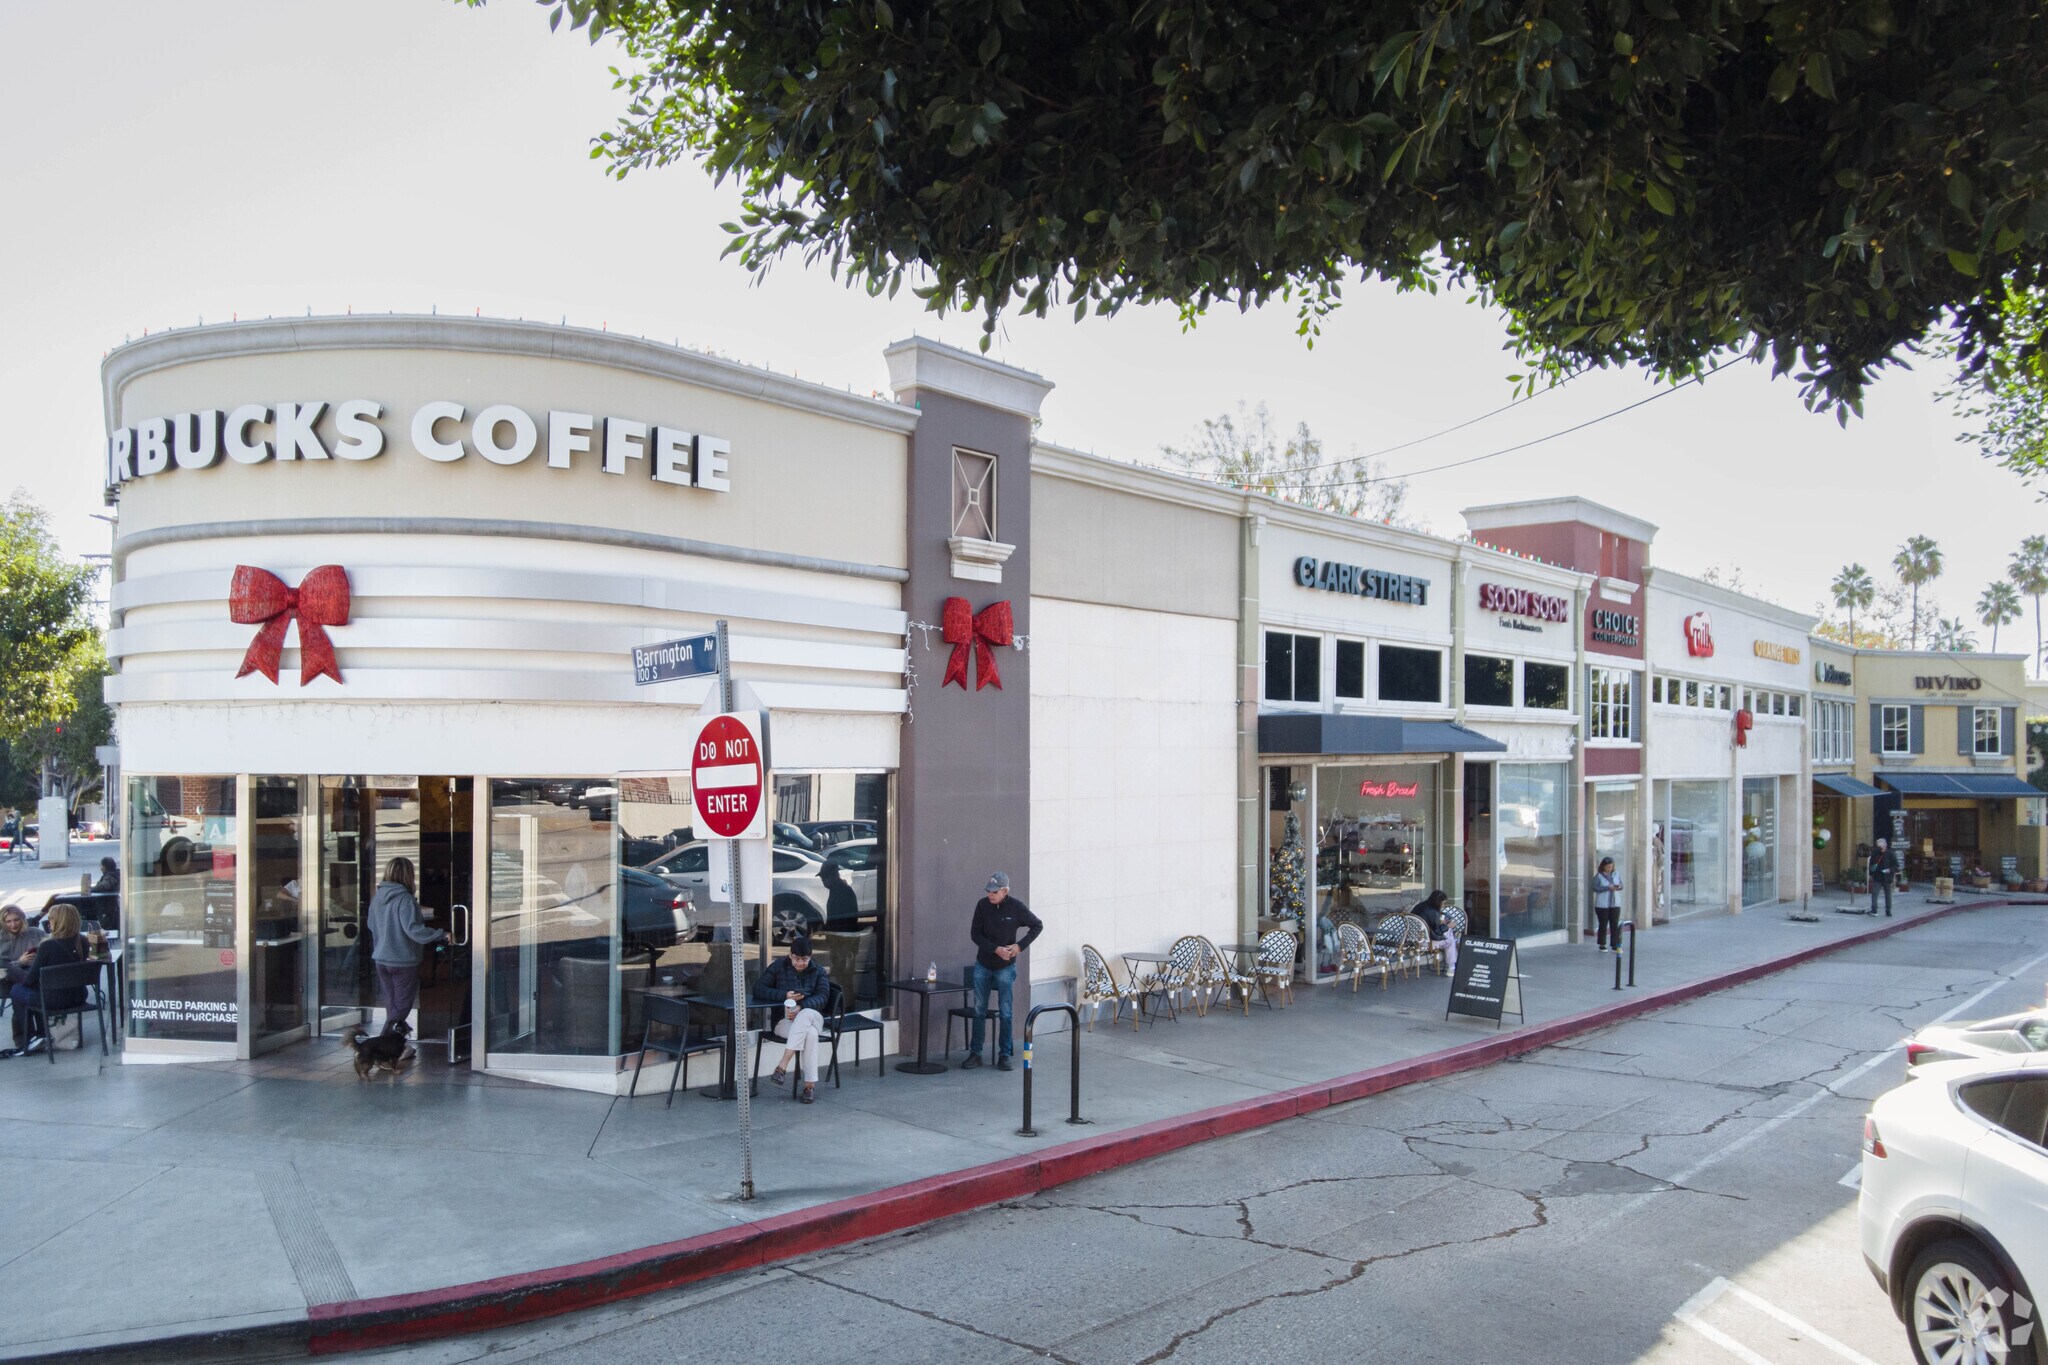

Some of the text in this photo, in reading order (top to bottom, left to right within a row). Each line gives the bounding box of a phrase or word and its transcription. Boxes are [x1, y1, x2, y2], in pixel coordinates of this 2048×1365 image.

[105, 399, 731, 493] RBUCKS COFFEE
[1293, 556, 1431, 606] CLARK STREET
[1480, 583, 1569, 623] SOOM SOOM
[1593, 609, 1639, 635] CHOICE
[1592, 631, 1639, 648] CONTEMPORARY
[1693, 622, 1713, 650] milk
[636, 637, 714, 669] Barrington Av
[637, 665, 658, 682] 100 S
[1915, 674, 1982, 691] DIVINO
[700, 738, 750, 761] DO NOT
[1361, 780, 1418, 797] Fresh Bread
[707, 793, 748, 814] ENTER
[209, 823, 222, 840] A
[1485, 942, 1509, 950] STREET
[131, 999, 183, 1009] VALIDATED
[184, 1001, 228, 1011] PARKING
[131, 1010, 238, 1022] REAR WITH PURCHASE
